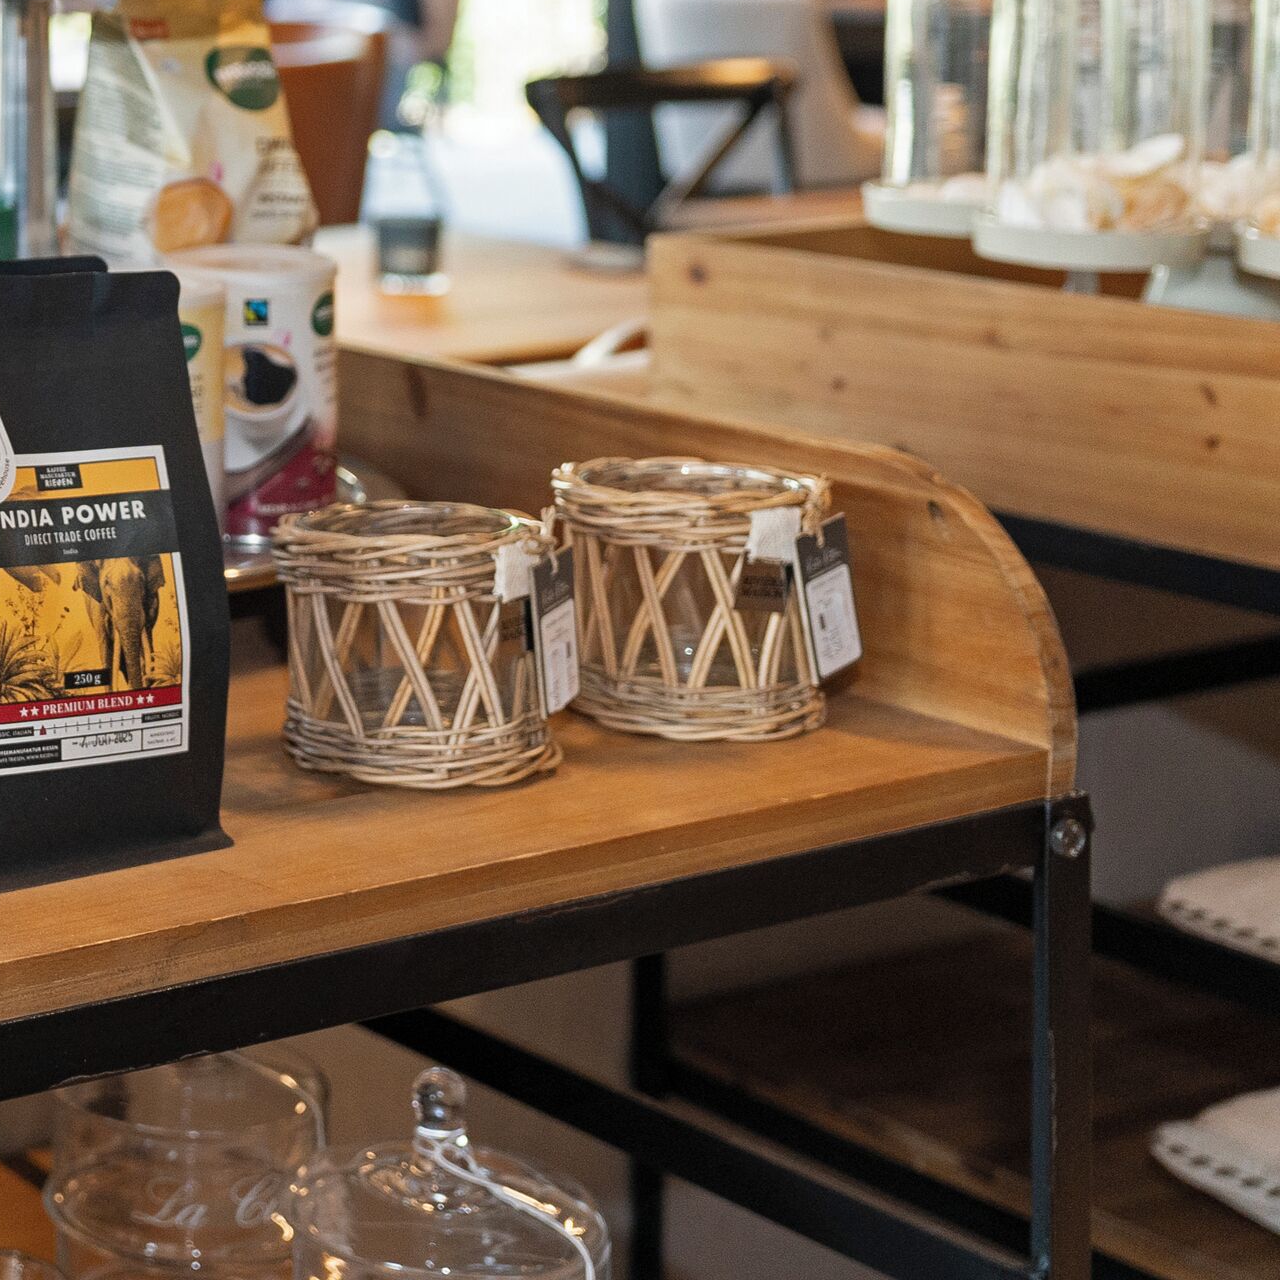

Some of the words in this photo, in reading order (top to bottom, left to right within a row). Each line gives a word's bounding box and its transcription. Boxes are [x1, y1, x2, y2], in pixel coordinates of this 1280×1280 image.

[61, 500, 146, 526] POWER
[24, 532, 52, 546] DIRECT
[54, 529, 82, 544] TRADE
[84, 526, 117, 541] COFFEE
[74, 672, 93, 686] 250
[94, 673, 102, 686] g
[42, 699, 95, 716] PREMIUM
[98, 695, 134, 709] BLEND
[131, 1176, 209, 1229] La
